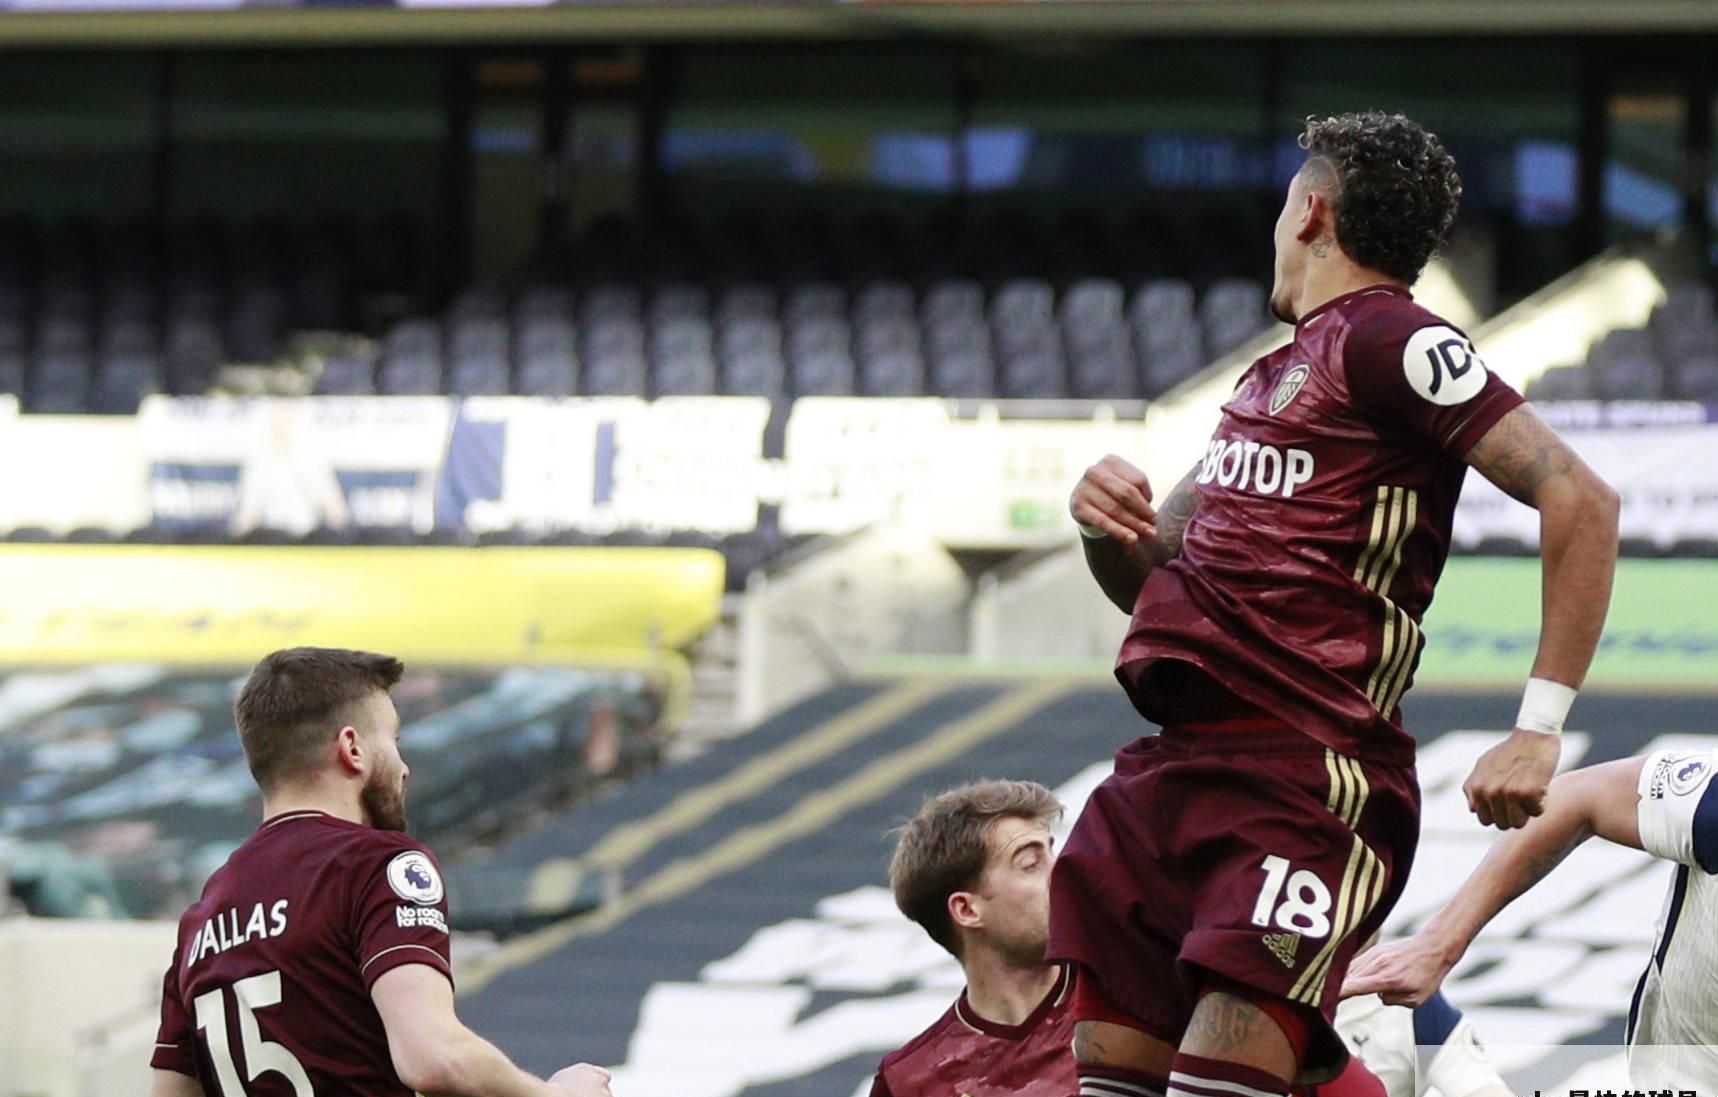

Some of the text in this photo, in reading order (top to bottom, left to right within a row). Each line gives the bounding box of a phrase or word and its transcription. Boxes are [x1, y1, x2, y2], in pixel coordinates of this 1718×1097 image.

[1425, 338, 1472, 396] JD
[1196, 439, 1315, 498] BOTOP
[396, 905, 416, 918] No
[1251, 854, 1332, 938] 18
[187, 898, 289, 969] DALLAS
